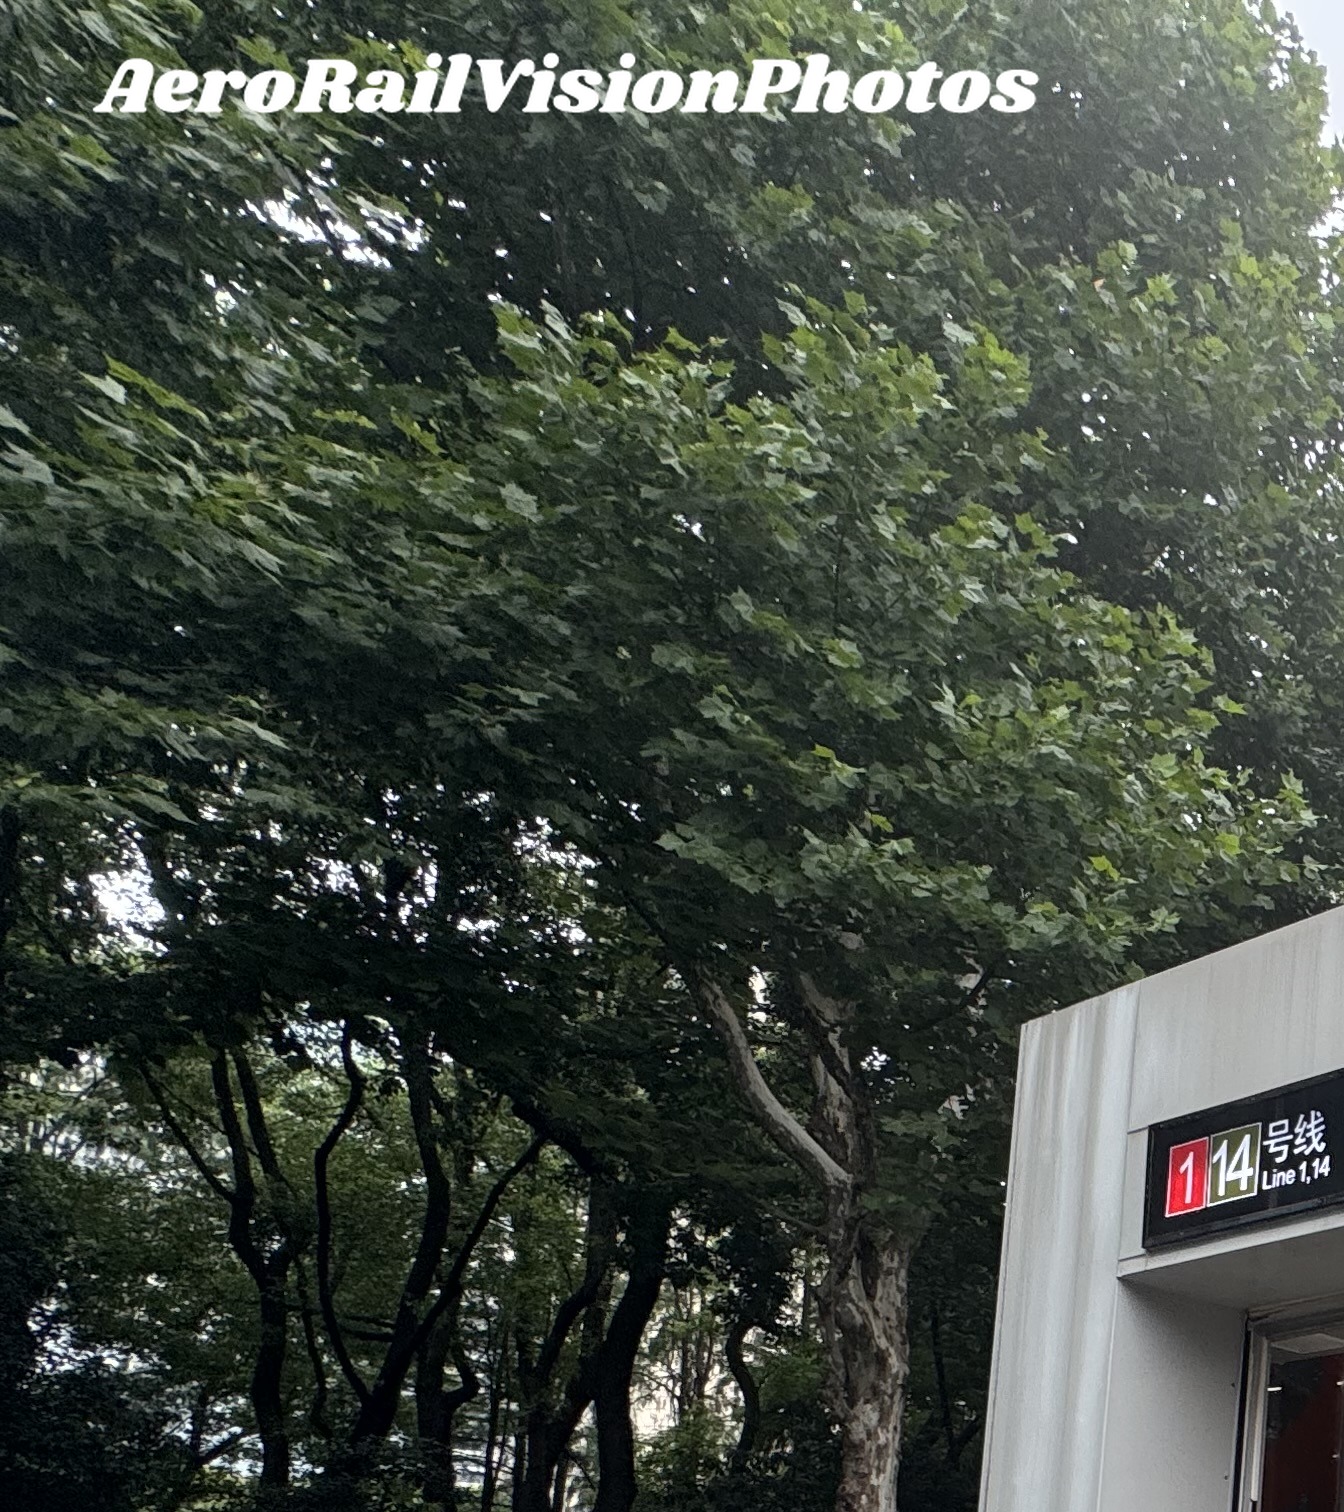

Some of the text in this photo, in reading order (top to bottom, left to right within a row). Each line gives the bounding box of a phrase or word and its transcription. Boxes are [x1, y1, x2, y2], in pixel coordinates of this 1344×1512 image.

[1179, 1109, 1327, 1205] 1 14 号线
[1262, 1167, 1296, 1191] Line
